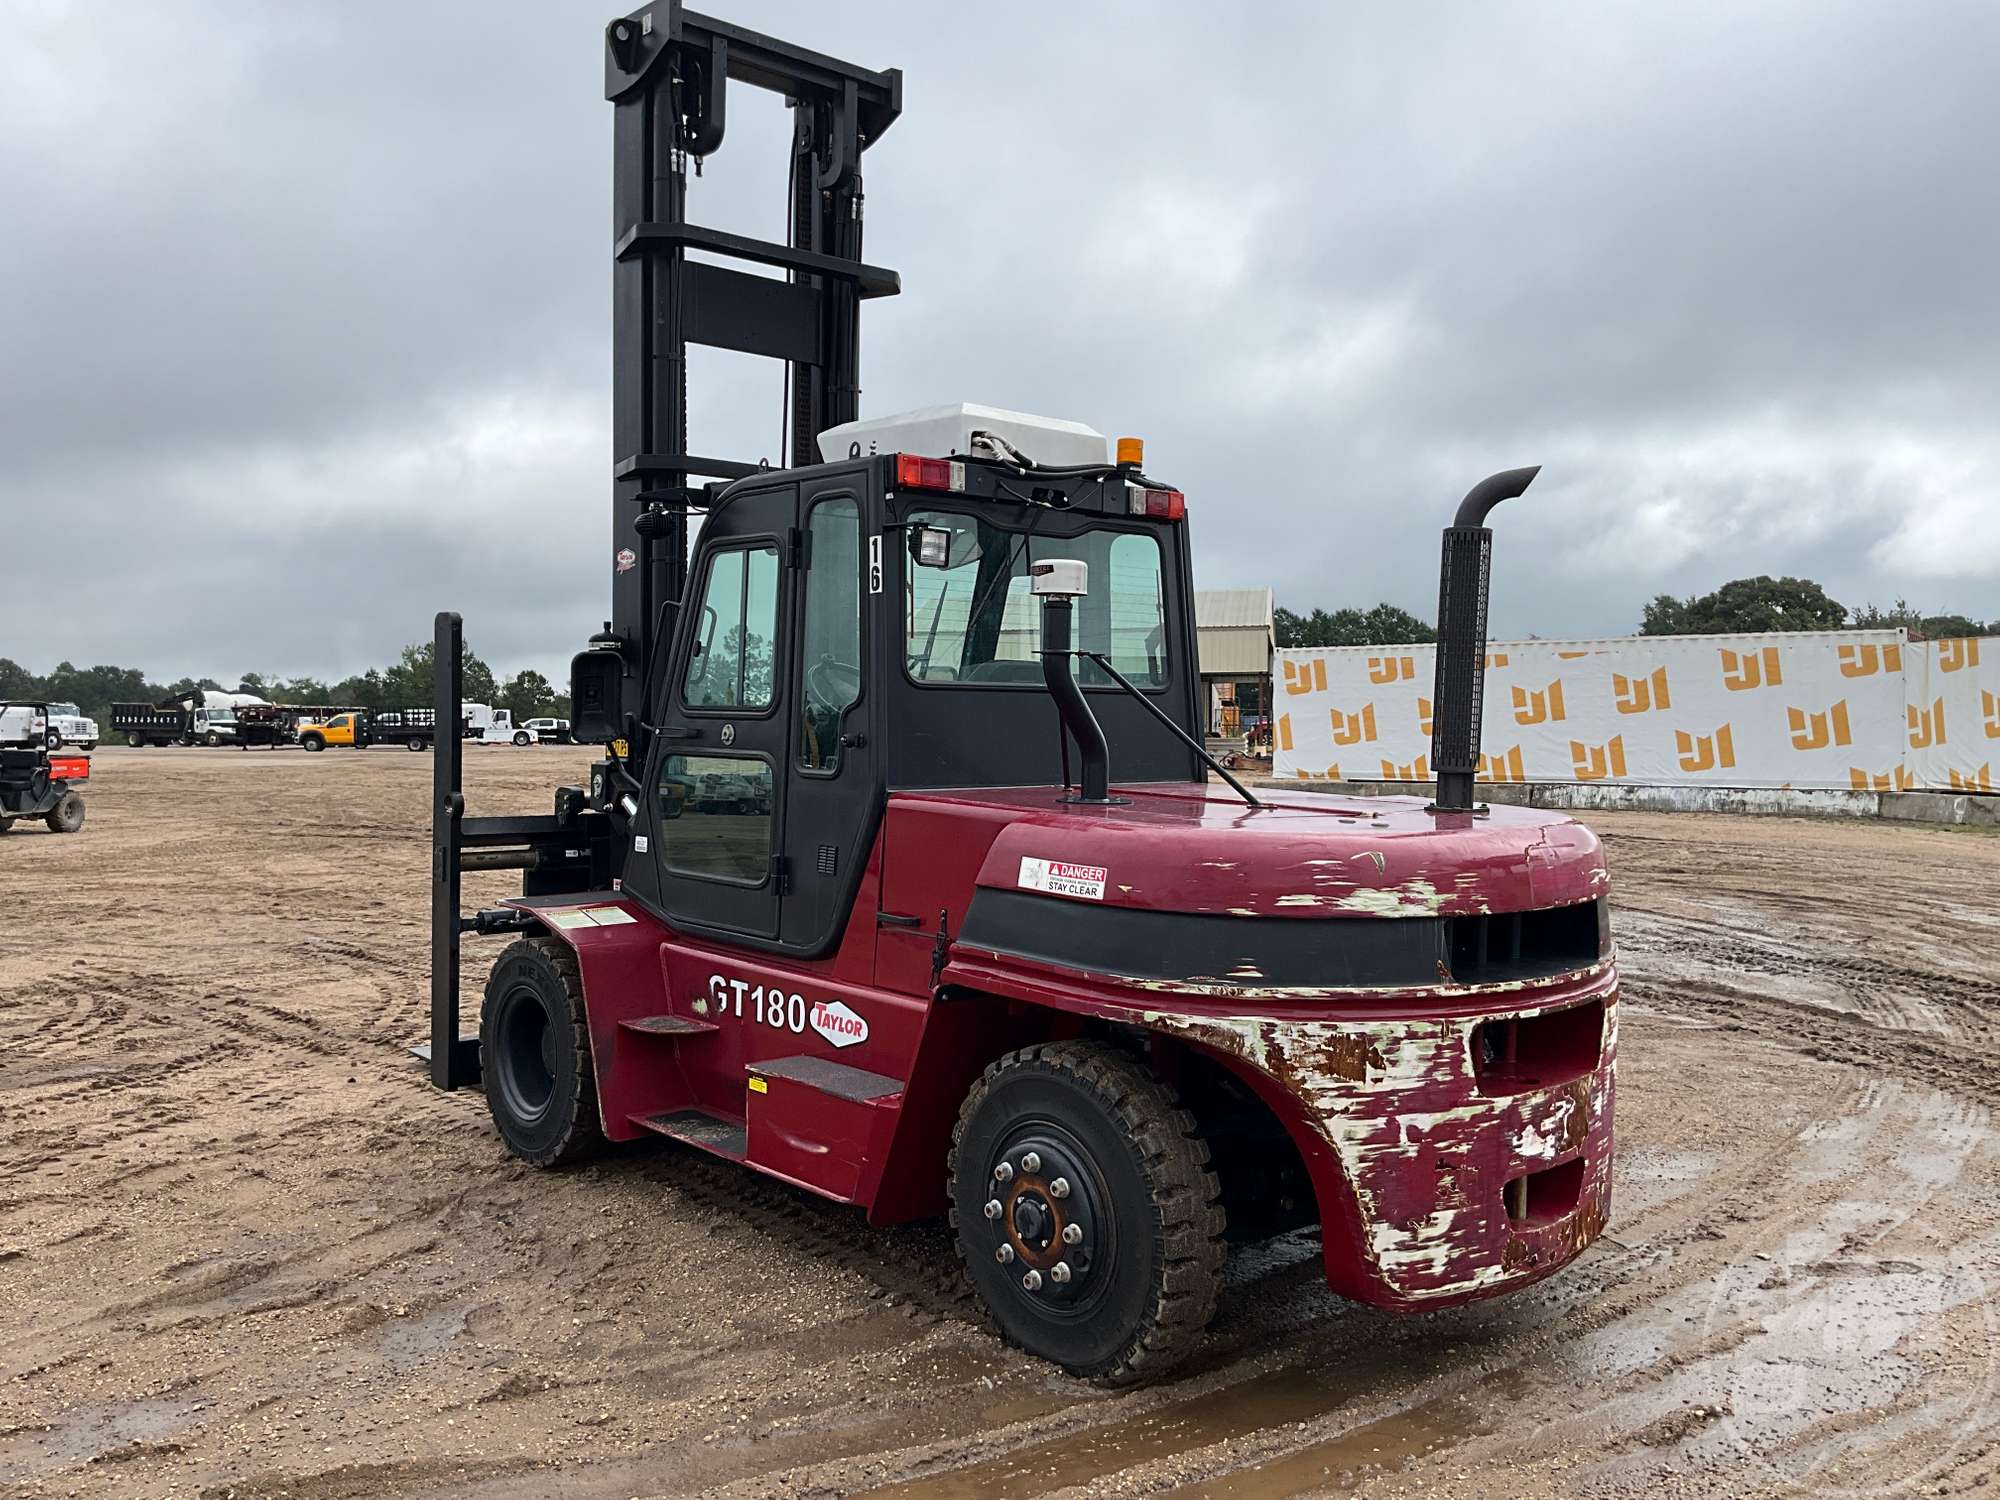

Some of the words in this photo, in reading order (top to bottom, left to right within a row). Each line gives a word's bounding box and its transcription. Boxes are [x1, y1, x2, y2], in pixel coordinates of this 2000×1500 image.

[871, 538, 881, 591] 16
[1048, 881, 1068, 892] STAY
[1069, 885, 1098, 897] CLEAR
[1060, 865, 1103, 881] DANGER
[709, 975, 806, 1033] GT180
[815, 1002, 863, 1037] TAYLOR
